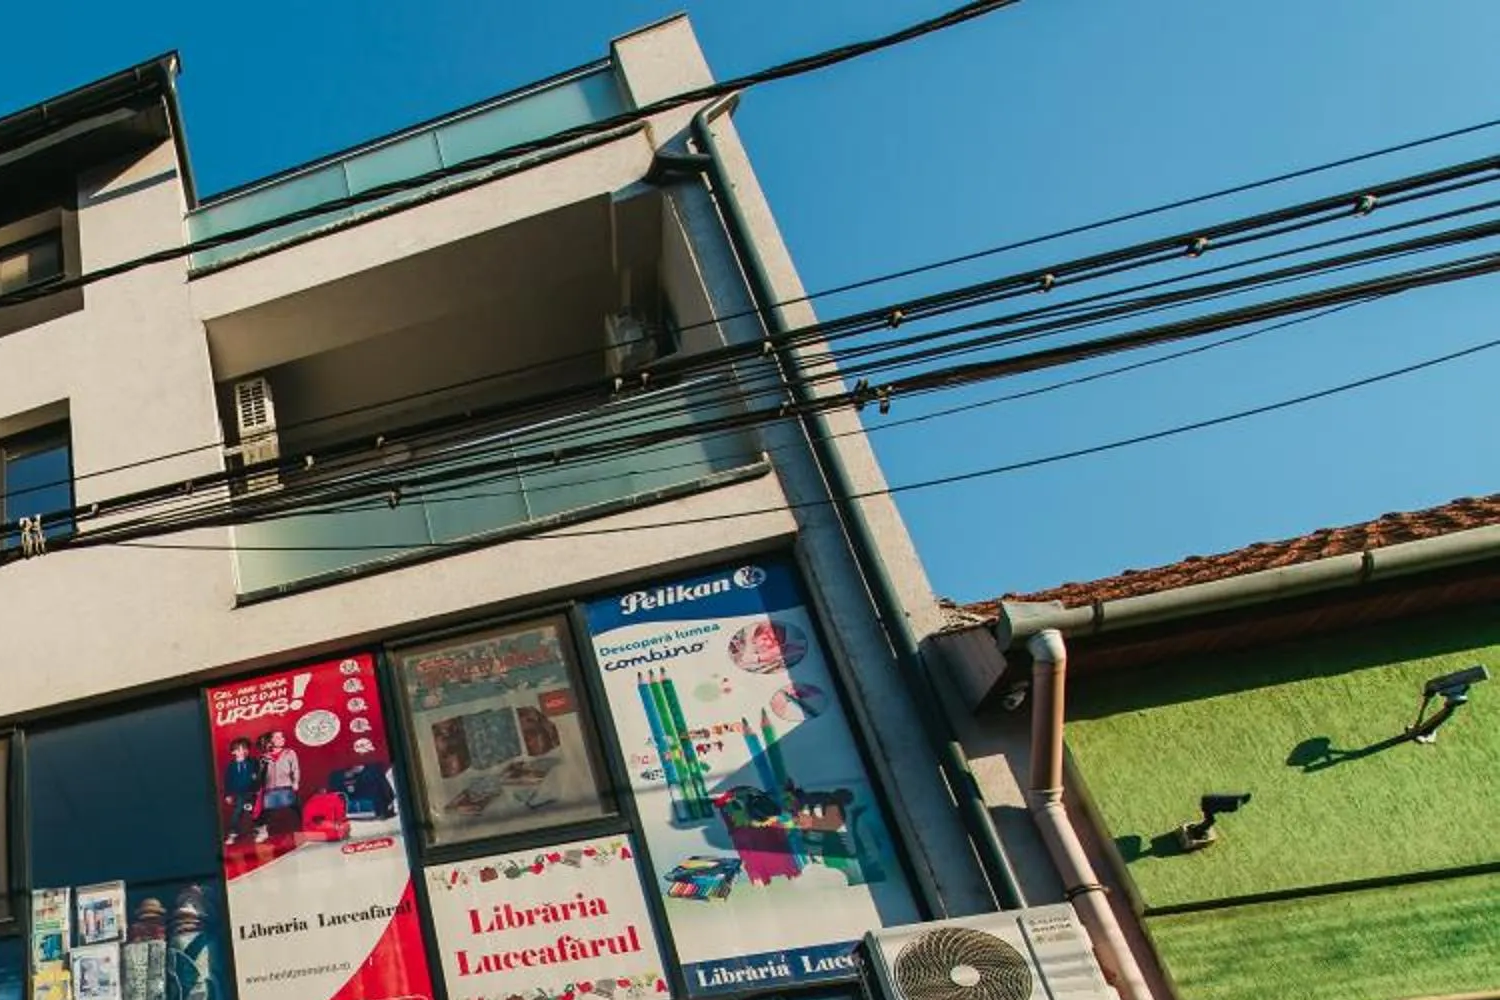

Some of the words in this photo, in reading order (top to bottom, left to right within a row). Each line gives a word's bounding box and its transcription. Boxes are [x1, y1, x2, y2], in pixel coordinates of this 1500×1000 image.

[620, 577, 731, 615] Pelikan
[675, 623, 721, 641] lumea
[604, 642, 704, 671] combino
